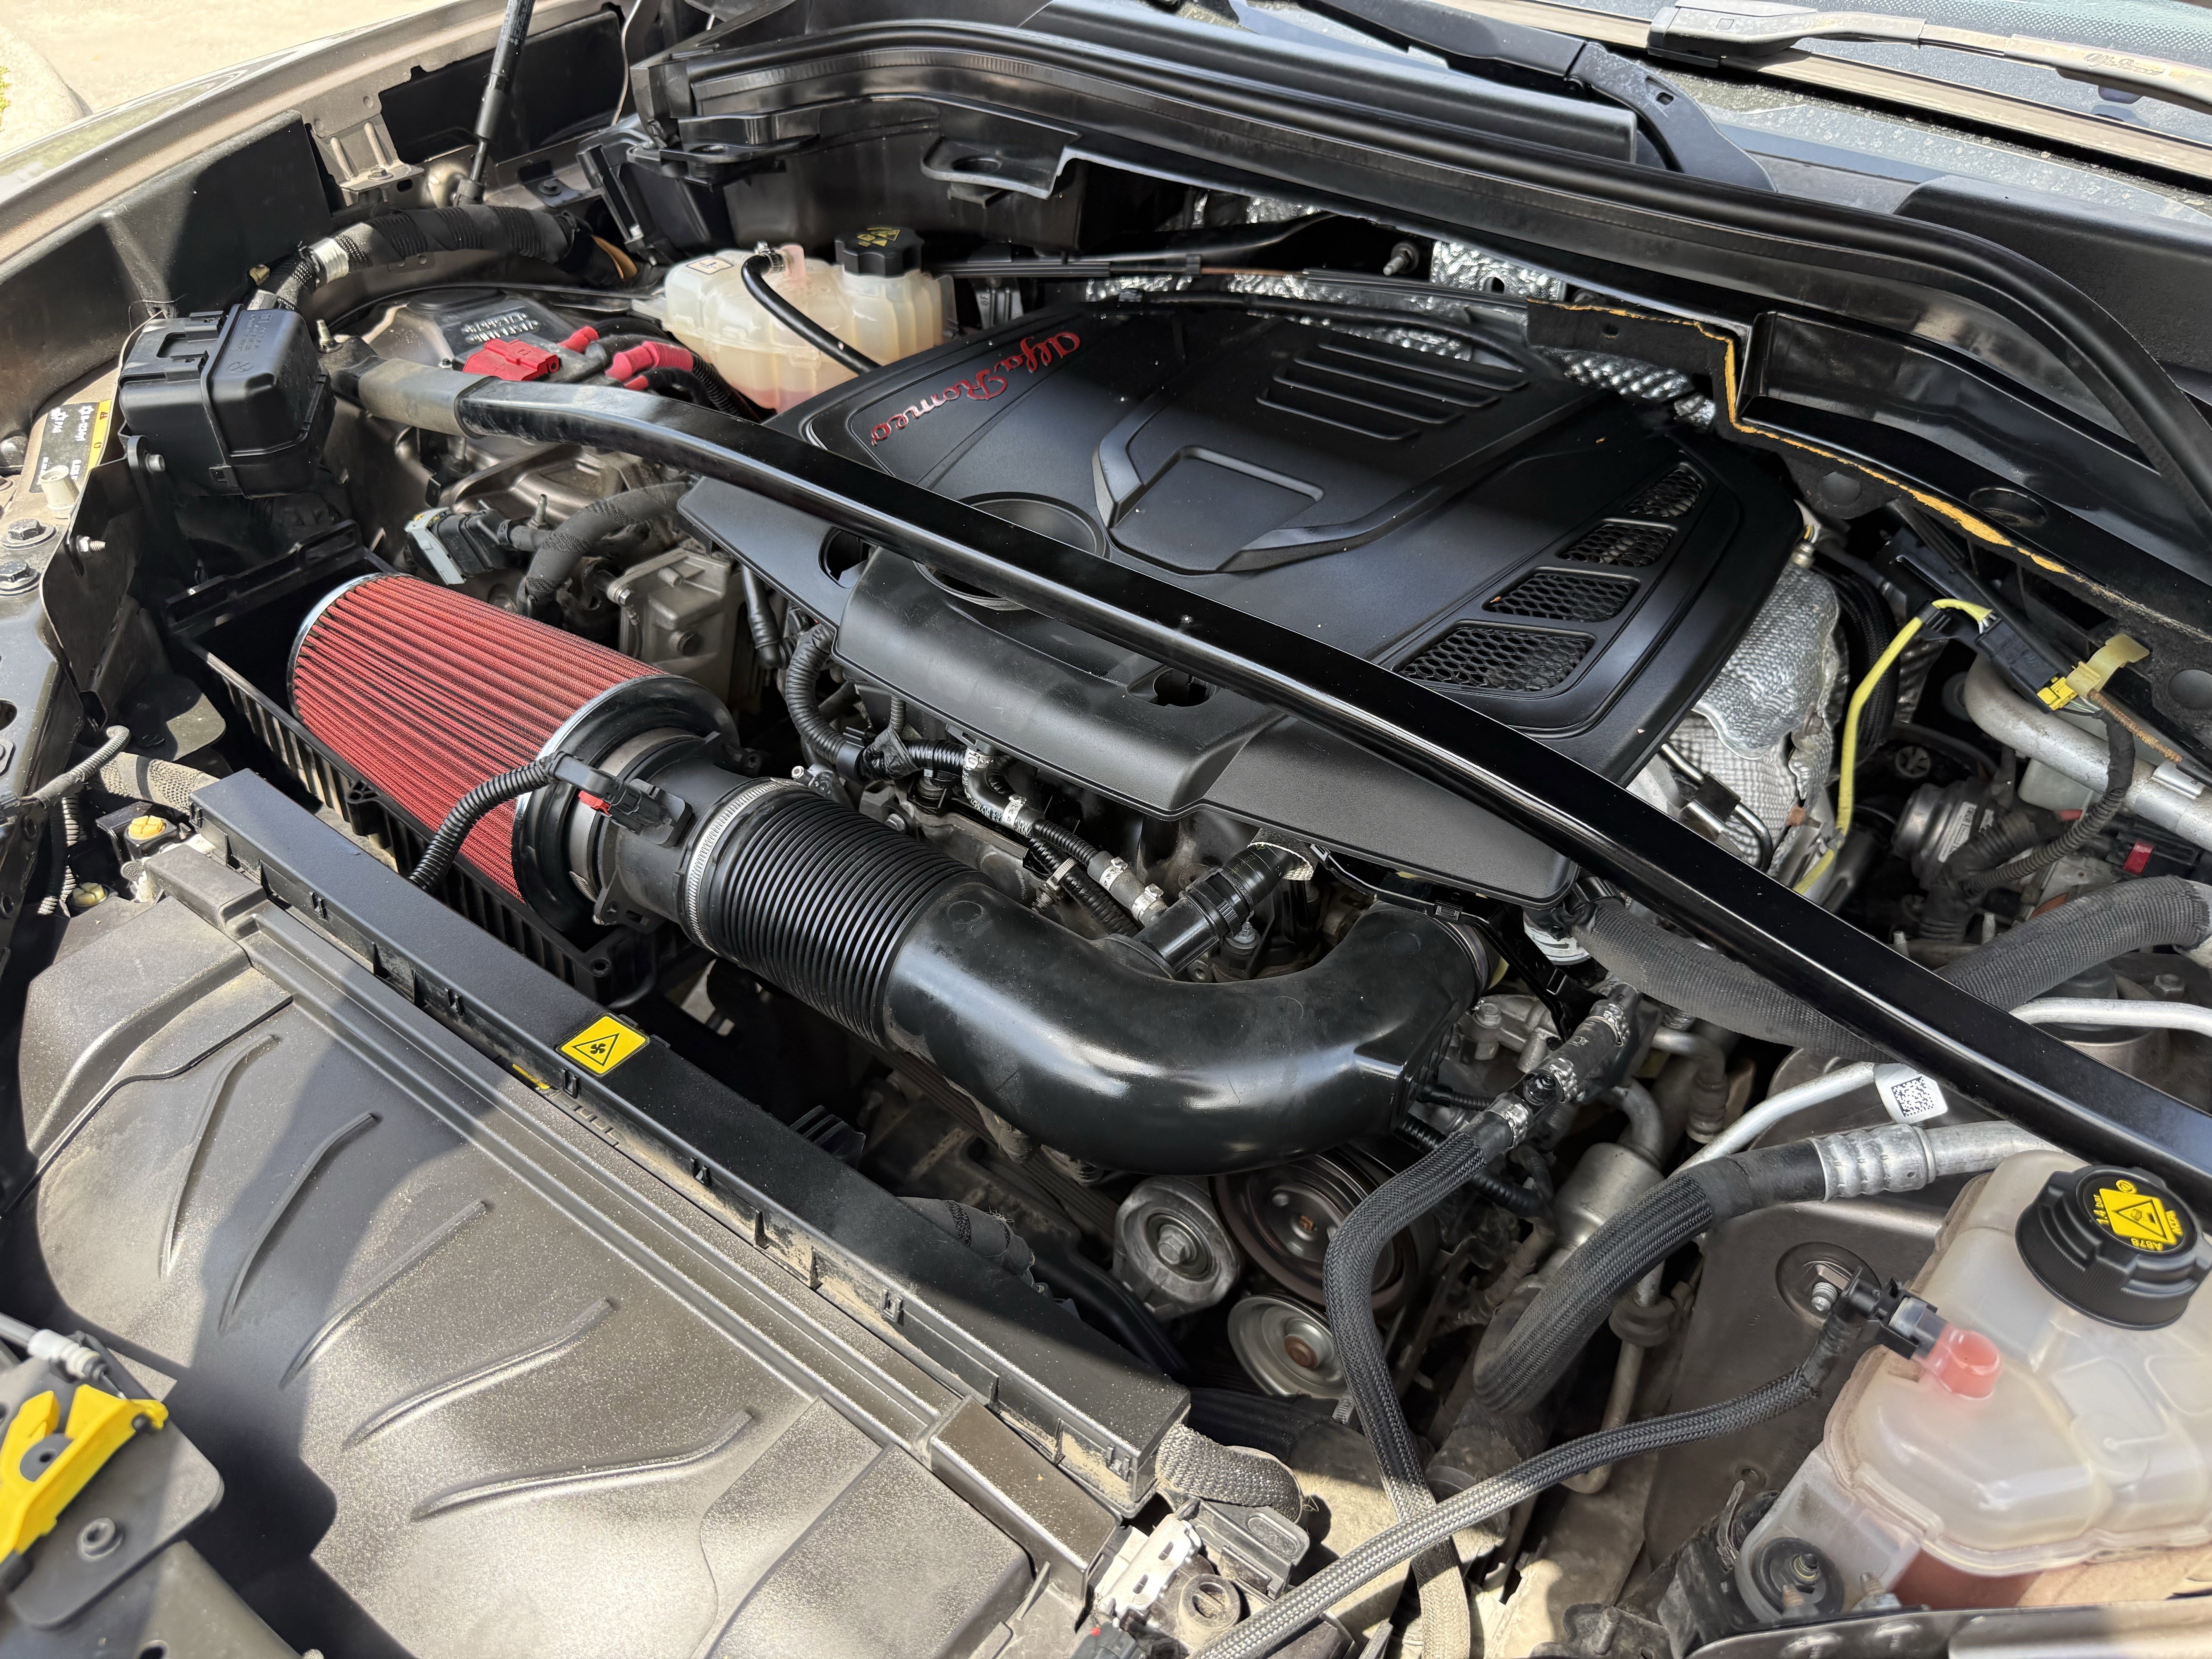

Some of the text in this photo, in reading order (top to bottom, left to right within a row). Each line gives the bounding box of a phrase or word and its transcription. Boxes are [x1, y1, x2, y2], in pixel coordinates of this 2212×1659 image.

[871, 332, 1080, 447] Alfa Romeo
[2093, 1194, 2109, 1225] 1.4 bar
[2131, 1238, 2162, 1251] A878
